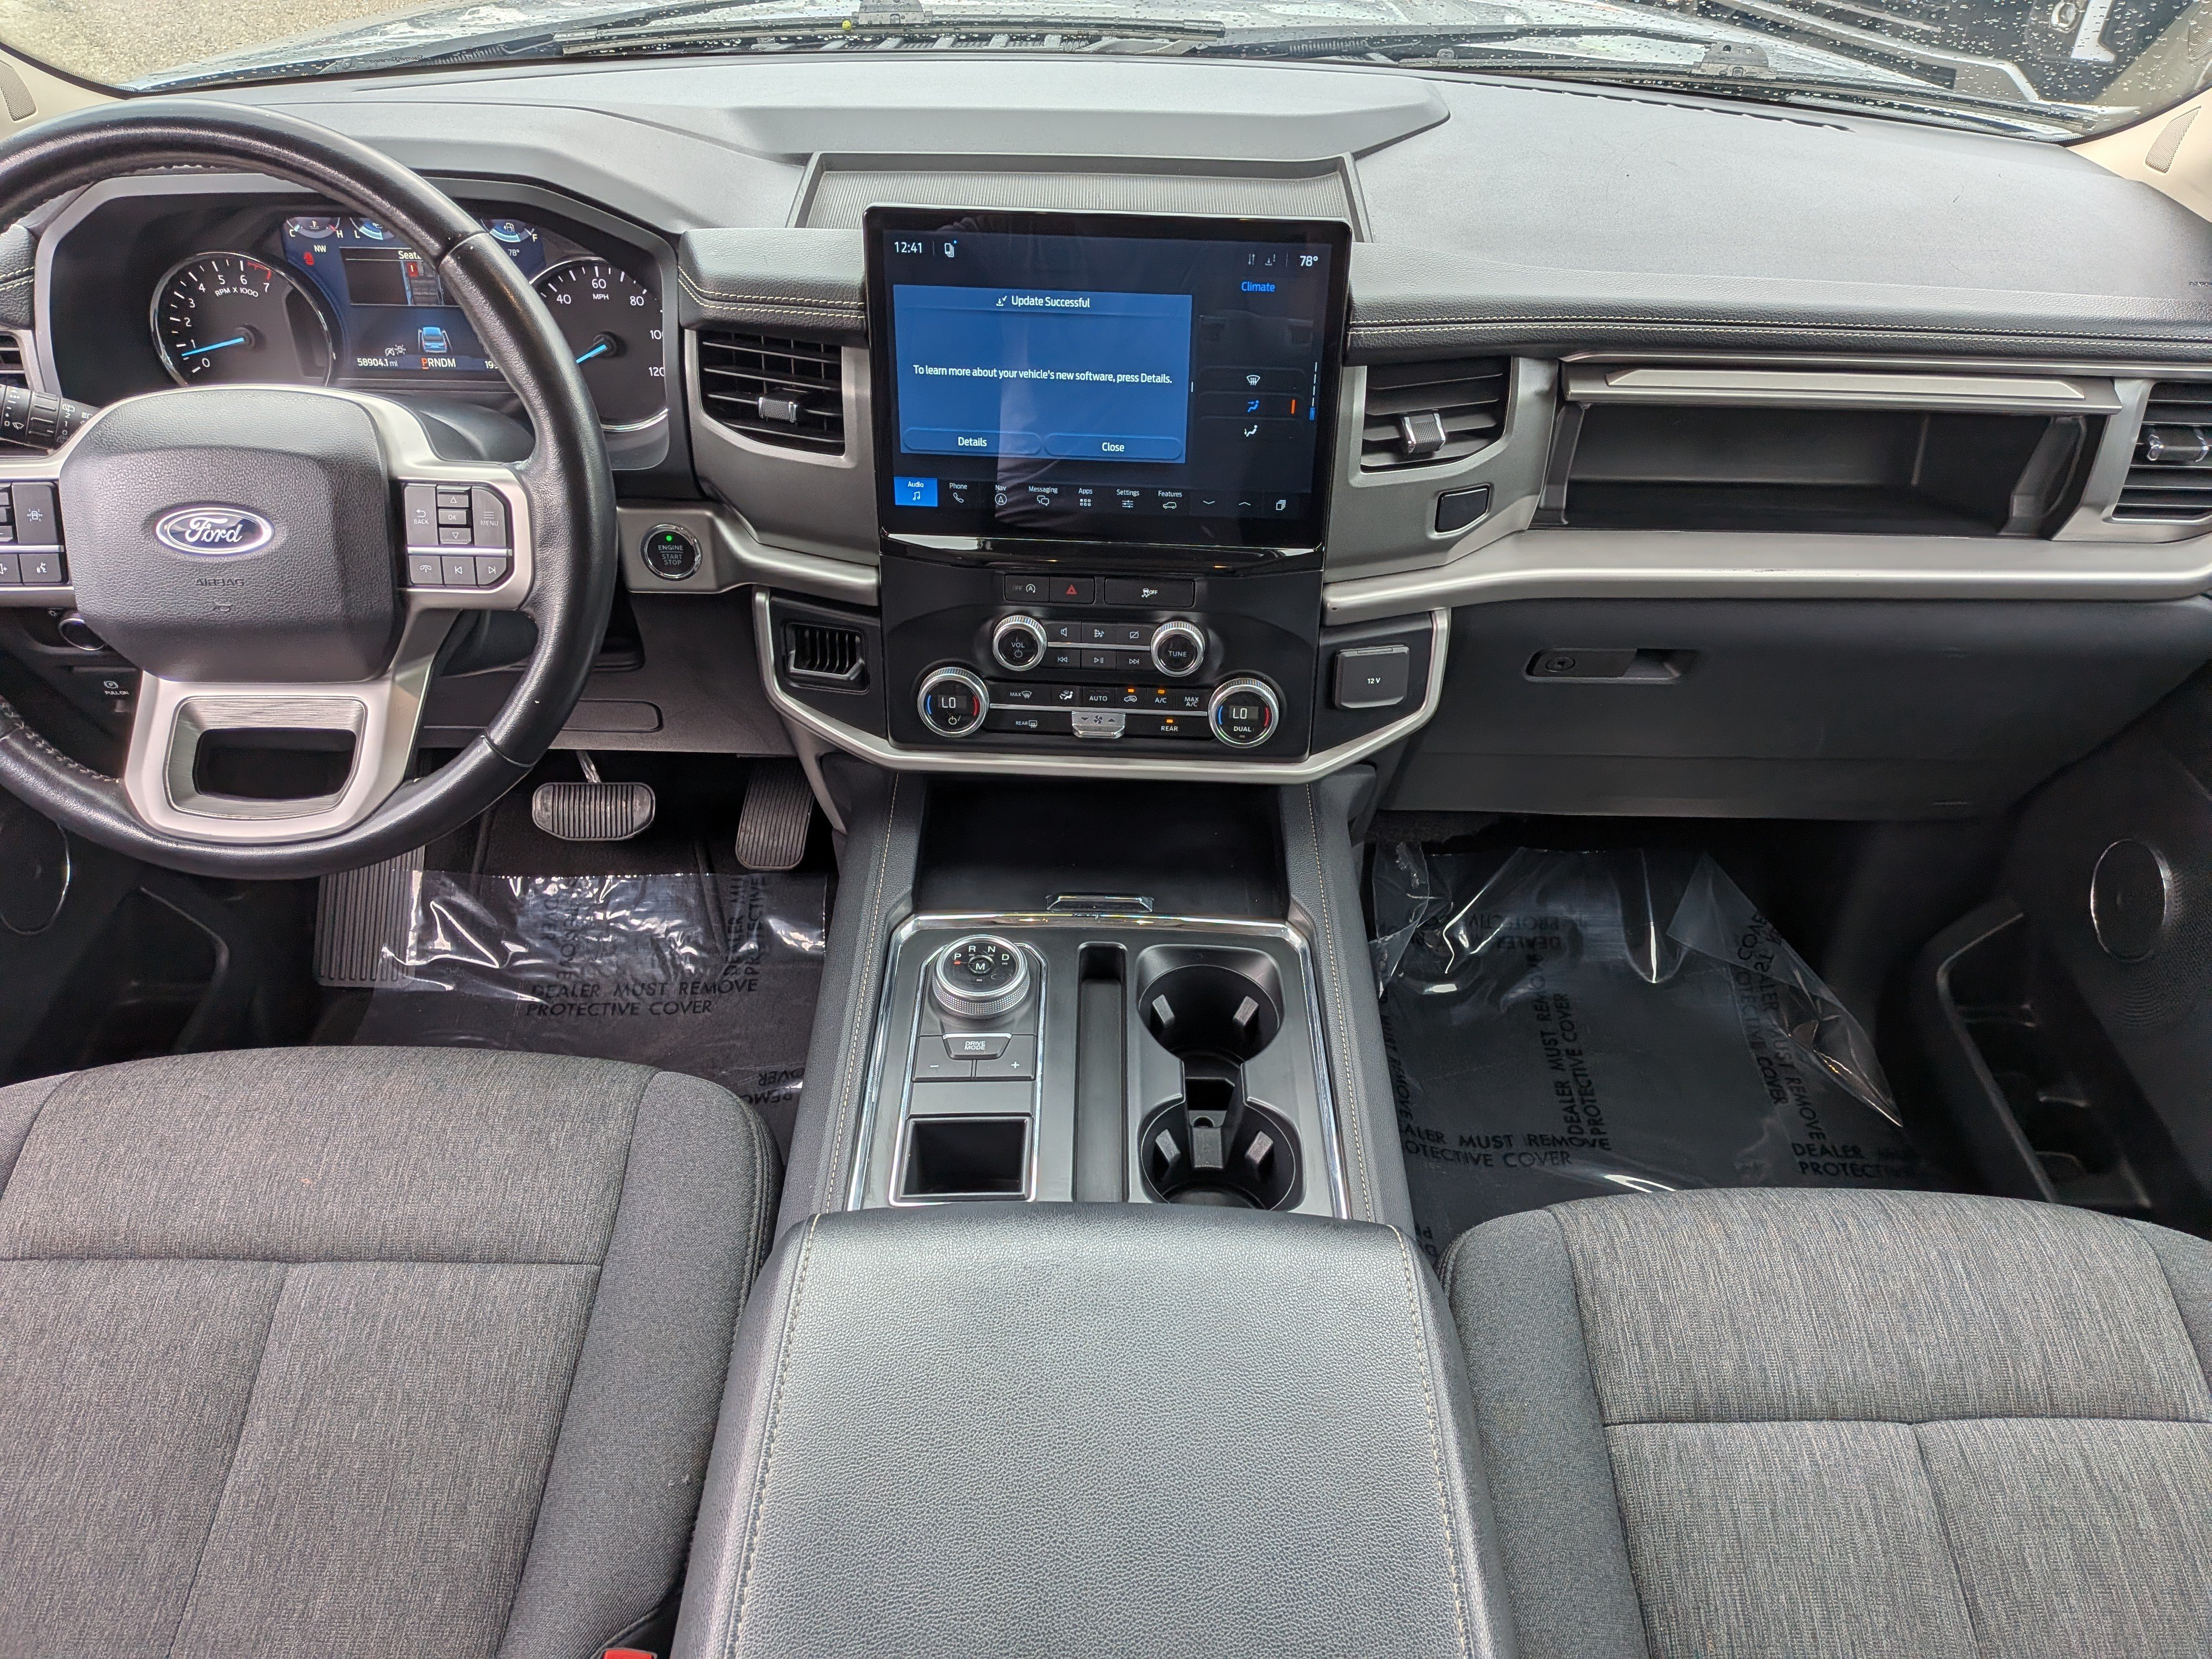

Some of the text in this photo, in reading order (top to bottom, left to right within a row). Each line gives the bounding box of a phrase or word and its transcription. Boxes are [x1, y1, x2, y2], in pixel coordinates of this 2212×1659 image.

[289, 229, 296, 237] C
[336, 229, 343, 238] H
[353, 230, 360, 238] L
[531, 233, 538, 242] F
[894, 241, 922, 253] 12:41
[1300, 255, 1318, 267] 78°
[217, 275, 226, 285] 5
[240, 275, 247, 285] 6
[591, 278, 607, 289] 60
[198, 283, 206, 293] 4
[263, 283, 270, 293] 7
[1241, 281, 1275, 292] Climate
[214, 287, 231, 297] RPM
[239, 287, 259, 298] 1000
[188, 298, 195, 308] 3
[556, 294, 572, 305] 40
[629, 295, 644, 306] 80
[1011, 295, 1091, 308] Update Successful
[184, 317, 192, 327] 2
[649, 330, 664, 340] 10
[190, 339, 196, 348] 1
[201, 358, 210, 368] 0
[357, 358, 388, 367] 58904.1
[421, 358, 456, 369] PRNDM
[913, 364, 1172, 383] To learn more about your vehicle's new software, press Details.
[958, 436, 987, 447] Details
[1102, 442, 1125, 452] Close
[185, 517, 243, 544] Ford
[195, 577, 244, 586] AIRBAG
[941, 696, 956, 708] LO
[1233, 708, 1248, 719] LO
[530, 978, 759, 999] DEALER MUST REMOVE
[525, 1000, 712, 1018] PROTECTIVE COVER
[1553, 993, 1608, 1135] PROTECTIVE COVER
[1539, 1030, 1567, 1072] MUST
[1553, 1079, 1585, 1136] DEALER
[1757, 1056, 1789, 1105] COVER
[1785, 1076, 1827, 1140] REMOVE
[1458, 1133, 1514, 1150] MUST
[1526, 1133, 1611, 1151] REMOVE
[1791, 1142, 1866, 1160] DEALER
[1503, 1149, 1572, 1168] COVER
